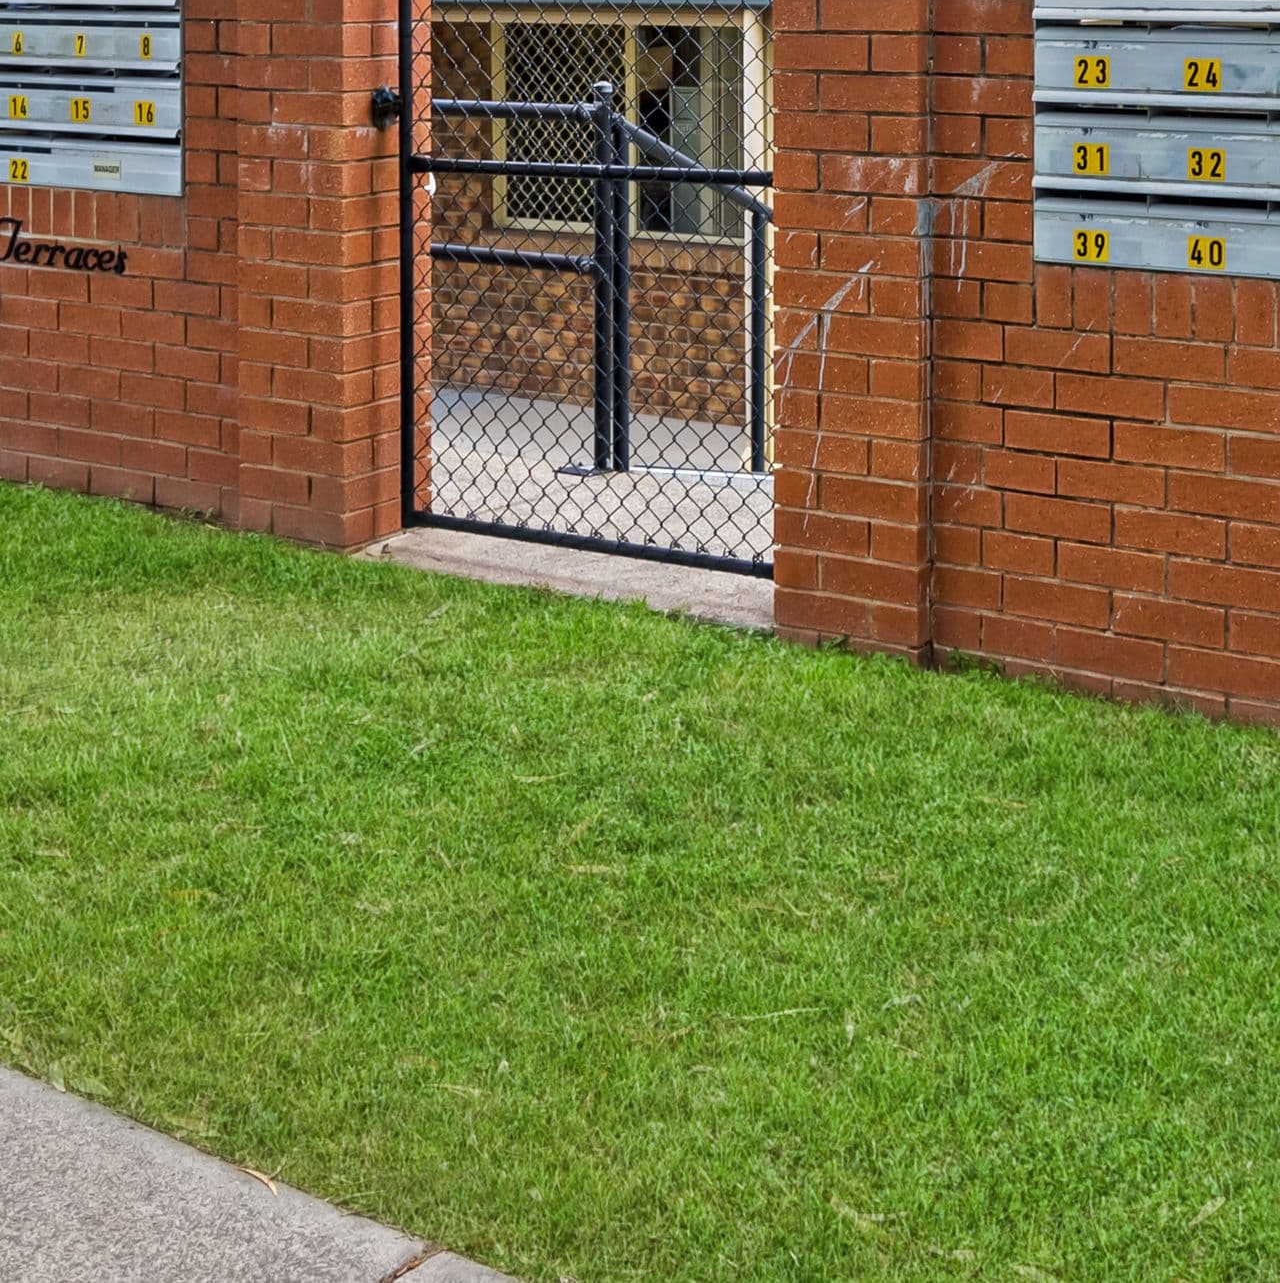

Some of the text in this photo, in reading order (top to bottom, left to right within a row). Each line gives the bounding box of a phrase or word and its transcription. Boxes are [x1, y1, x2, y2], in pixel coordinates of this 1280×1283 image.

[14, 33, 22, 53] 6
[76, 35, 84, 54] 7
[141, 36, 150, 56] 8
[1077, 58, 1107, 84] 23
[1187, 61, 1218, 88] 24
[11, 97, 27, 116] 14
[73, 100, 90, 120] 15
[137, 103, 154, 123] 16
[1076, 145, 1105, 172] 31
[1191, 150, 1222, 178] 32
[11, 160, 28, 180] 22
[1076, 231, 1105, 259] 39
[1190, 239, 1223, 267] 40
